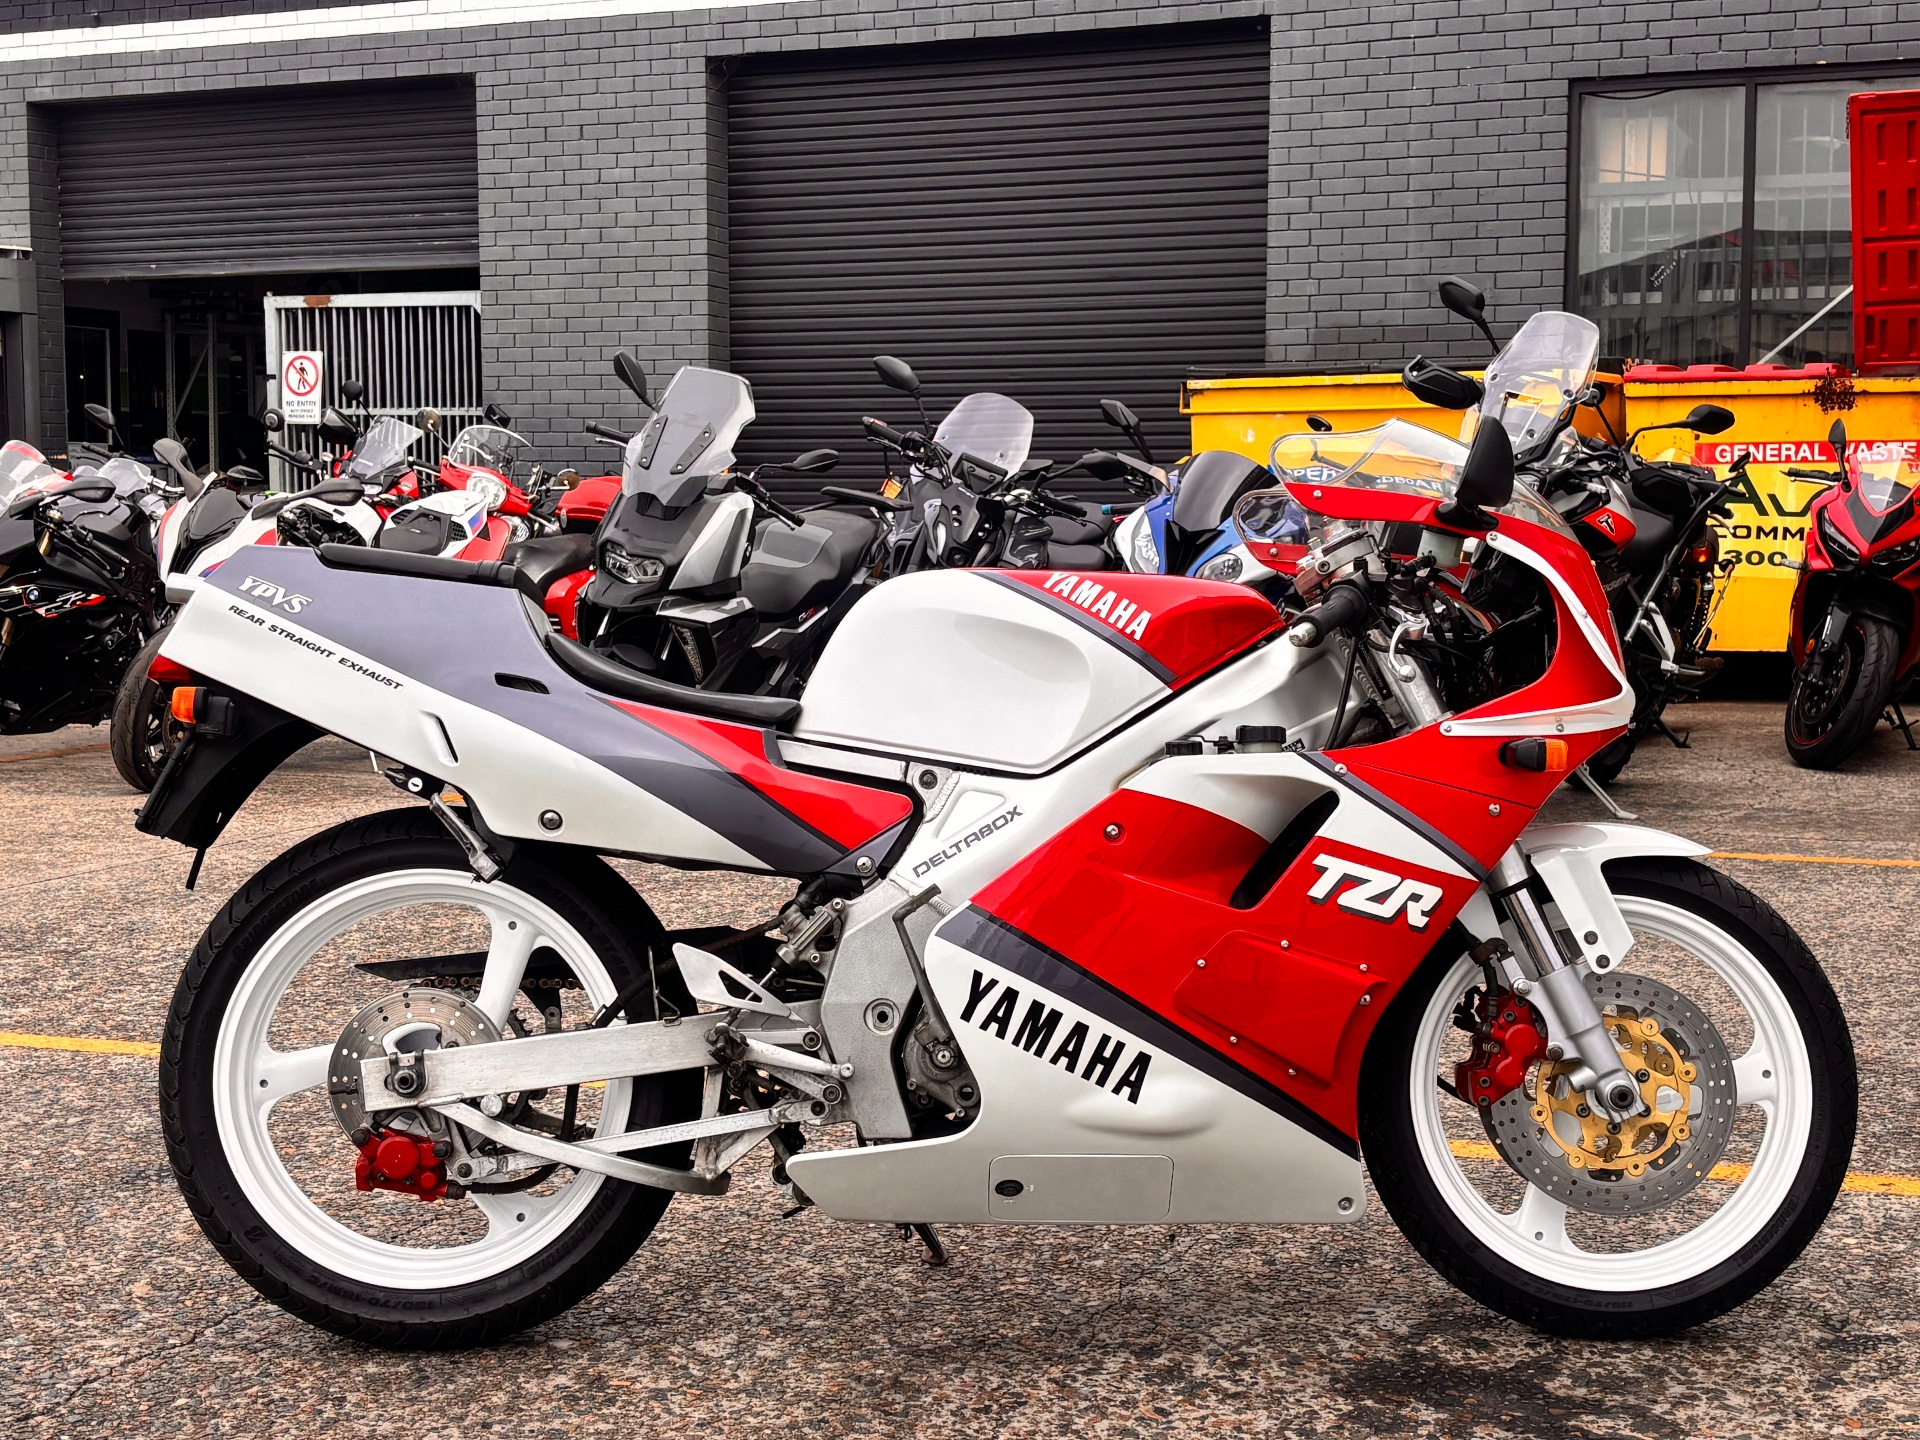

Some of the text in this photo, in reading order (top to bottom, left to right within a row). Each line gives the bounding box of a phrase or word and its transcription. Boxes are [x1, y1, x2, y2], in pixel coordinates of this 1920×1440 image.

[1714, 443, 1828, 462] GENERAL
[238, 575, 313, 614] YPVS
[1042, 571, 1152, 641] YAMAHA
[228, 605, 404, 690] REAR STRAIGHT EXHAUST
[912, 805, 1024, 878] DELTABOX
[1306, 853, 1443, 933] TZR
[959, 968, 1153, 1106] YAMAHA
